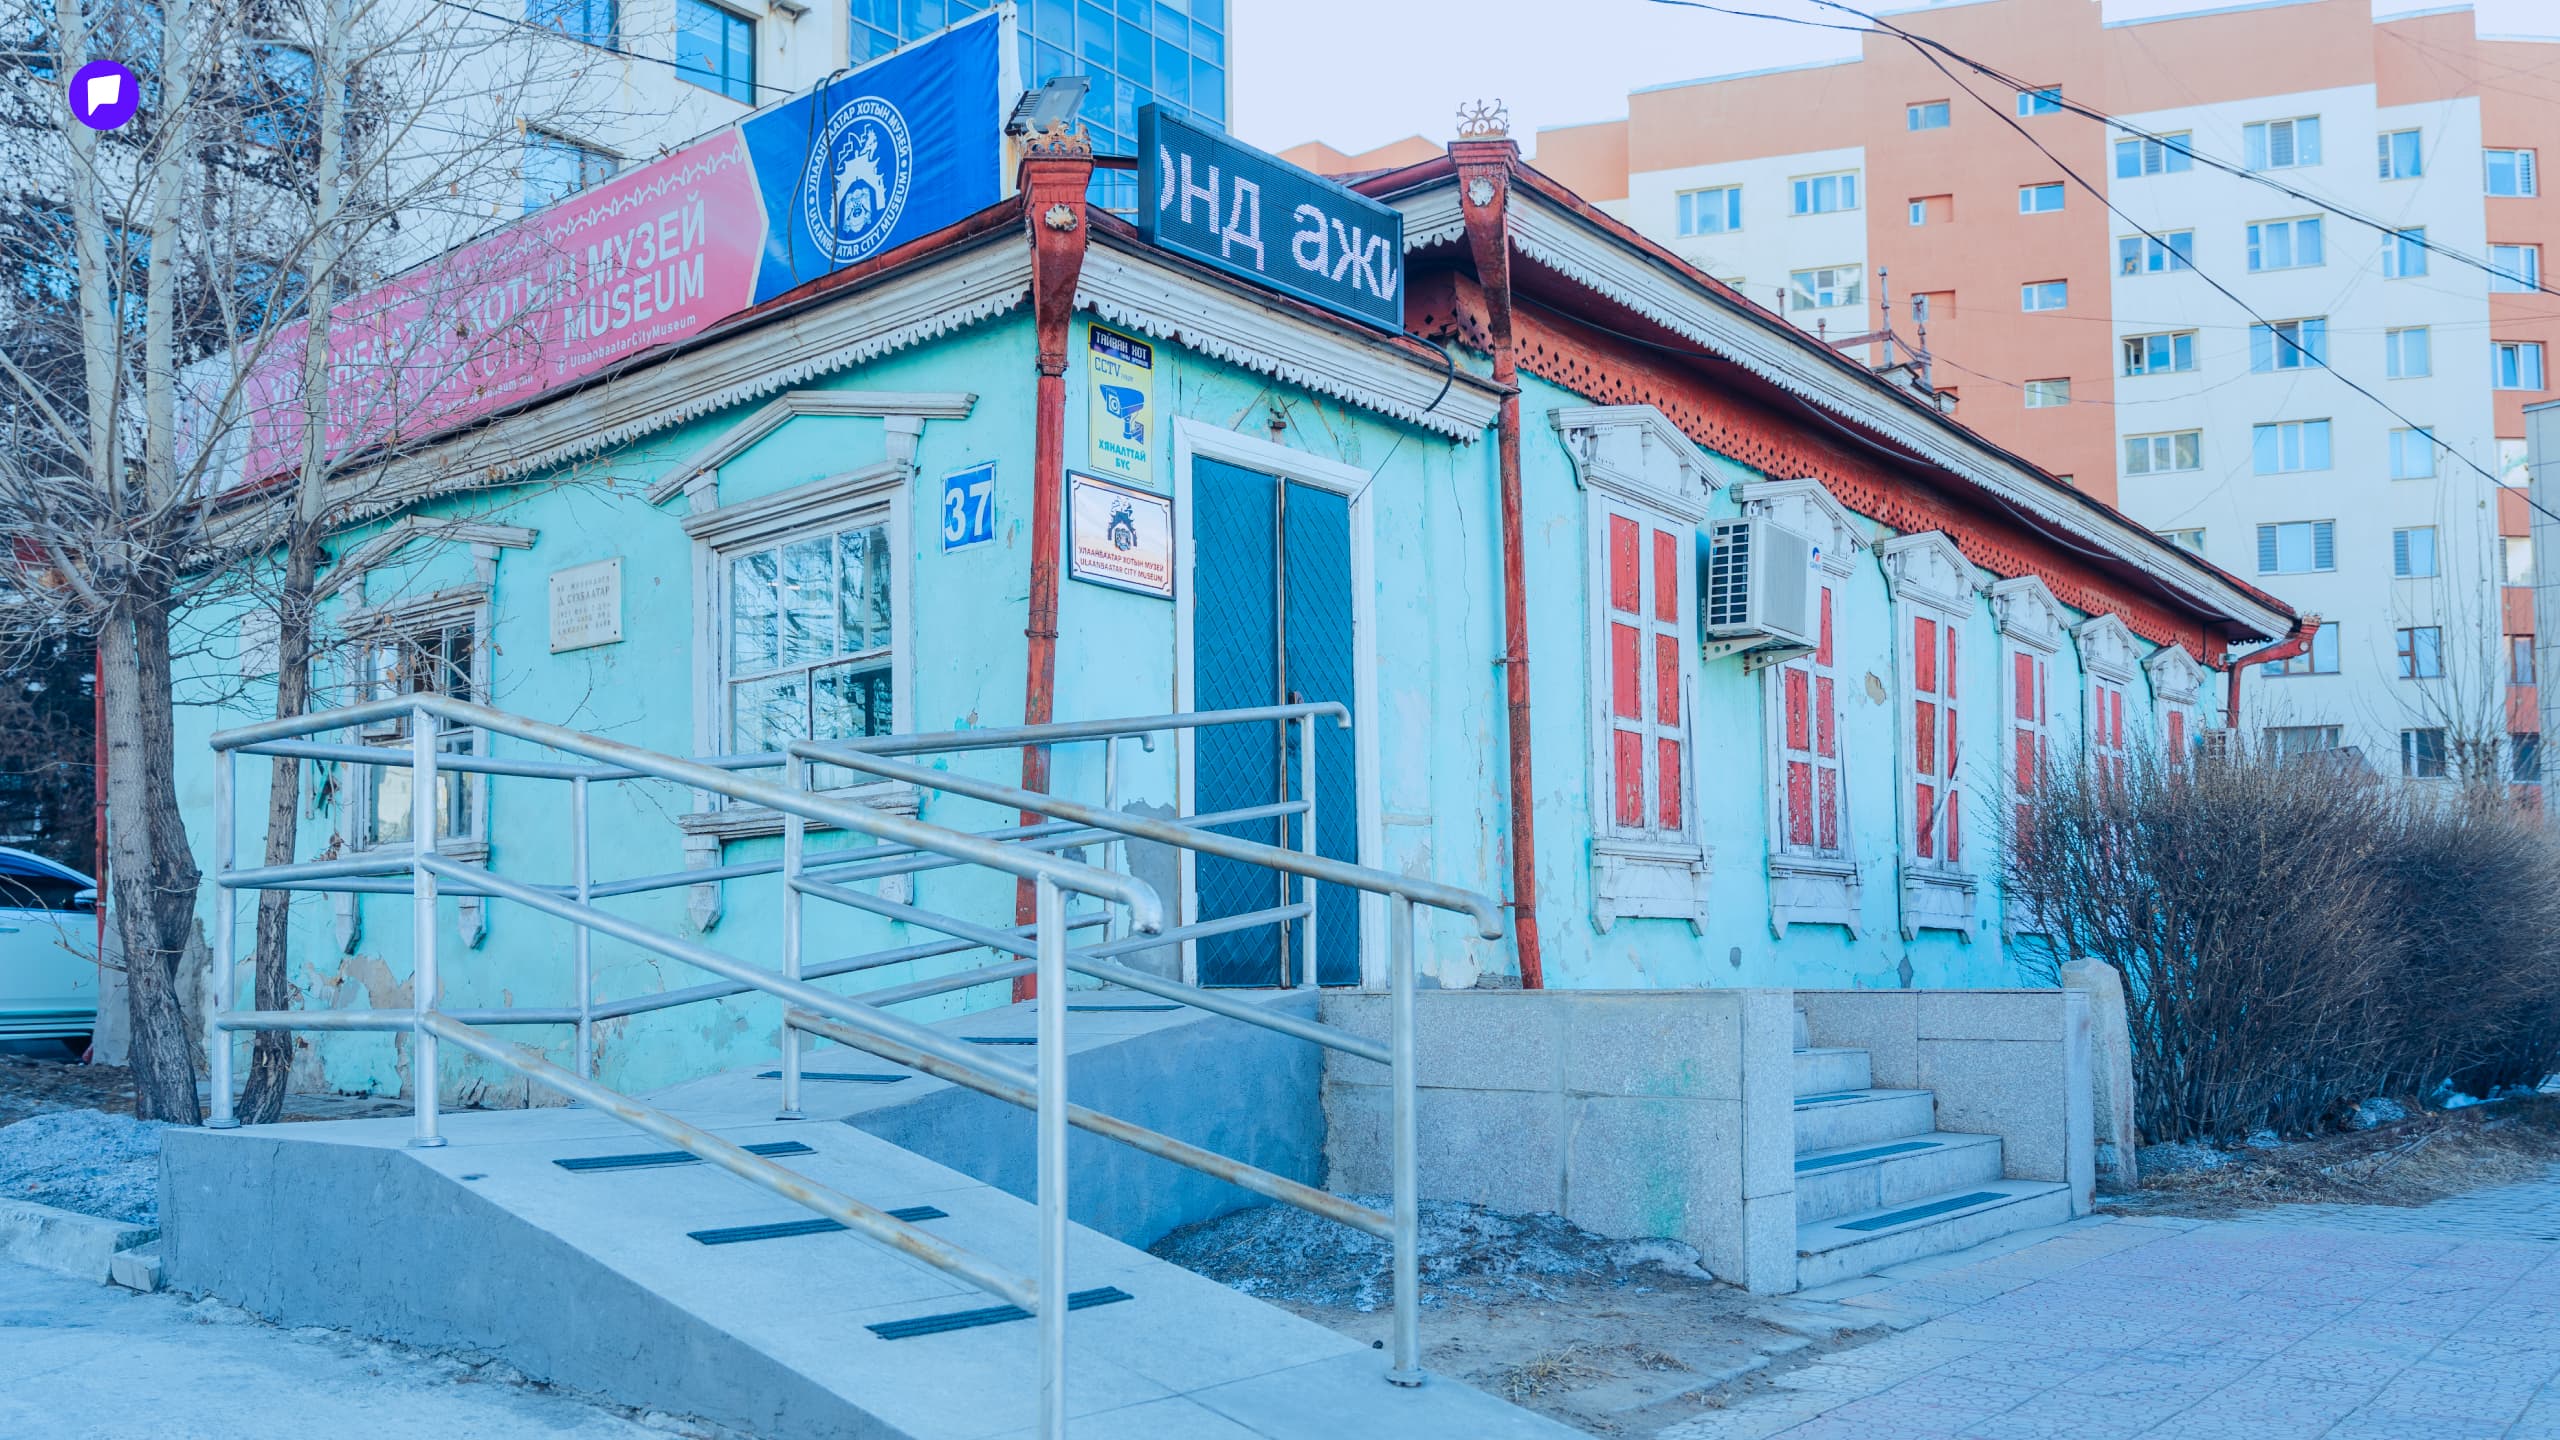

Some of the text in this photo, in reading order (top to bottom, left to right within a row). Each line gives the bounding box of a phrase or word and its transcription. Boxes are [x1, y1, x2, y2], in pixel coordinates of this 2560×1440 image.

[856, 101, 890, 121] ХОТЫН
[887, 117, 909, 162] МУЗЕЙ
[808, 170, 908, 257] ULAANBATAR CITY MUSEUM
[465, 253, 577, 334] ХОТЫН
[588, 190, 705, 289] МУЗЕЙ
[482, 314, 548, 377] CITY
[563, 253, 705, 348] MUSEUM
[570, 314, 696, 368] UlaanbaatarCityMuseum
[1094, 356, 1121, 377] CCTV
[1095, 331, 1147, 361] ТАЙВАН ХОТ
[1098, 439, 1146, 463] ХЯНАЛТТАЙ
[945, 480, 992, 542] 37
[1078, 546, 1122, 562] УЛААНБААТАР
[1080, 557, 1163, 582] ULAANBAATAR CITY MUSEUM
